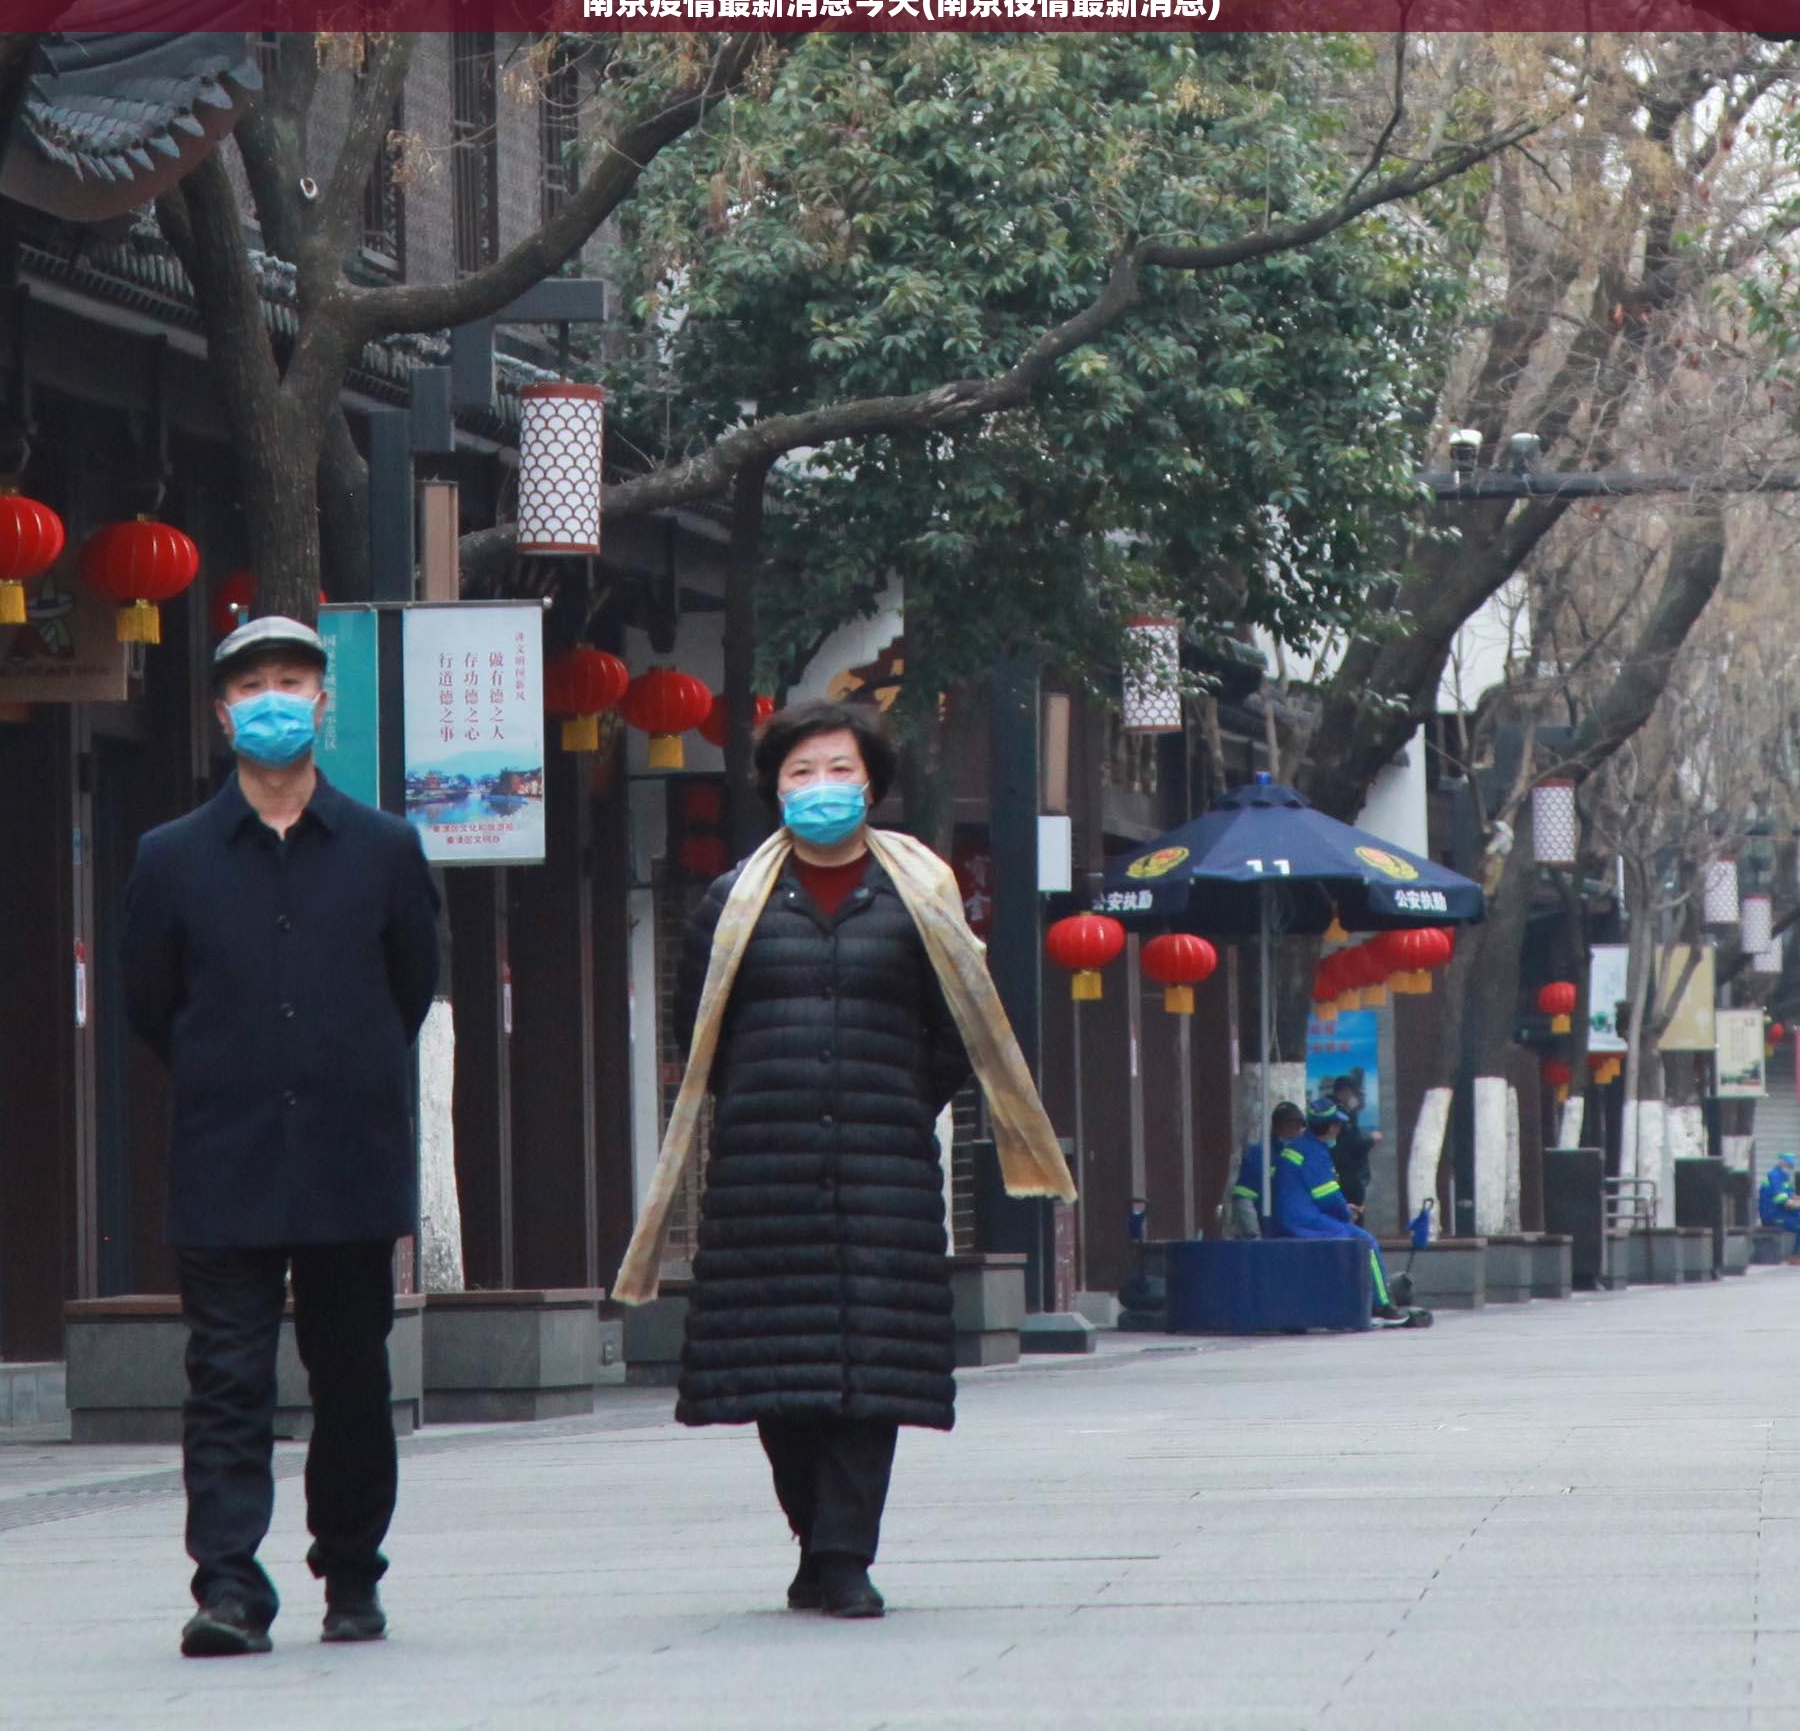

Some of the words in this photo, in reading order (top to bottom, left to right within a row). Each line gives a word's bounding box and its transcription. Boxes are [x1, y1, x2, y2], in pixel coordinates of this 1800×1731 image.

[439, 652, 454, 742] 行道德之事
[489, 652, 504, 740] 做有德之人
